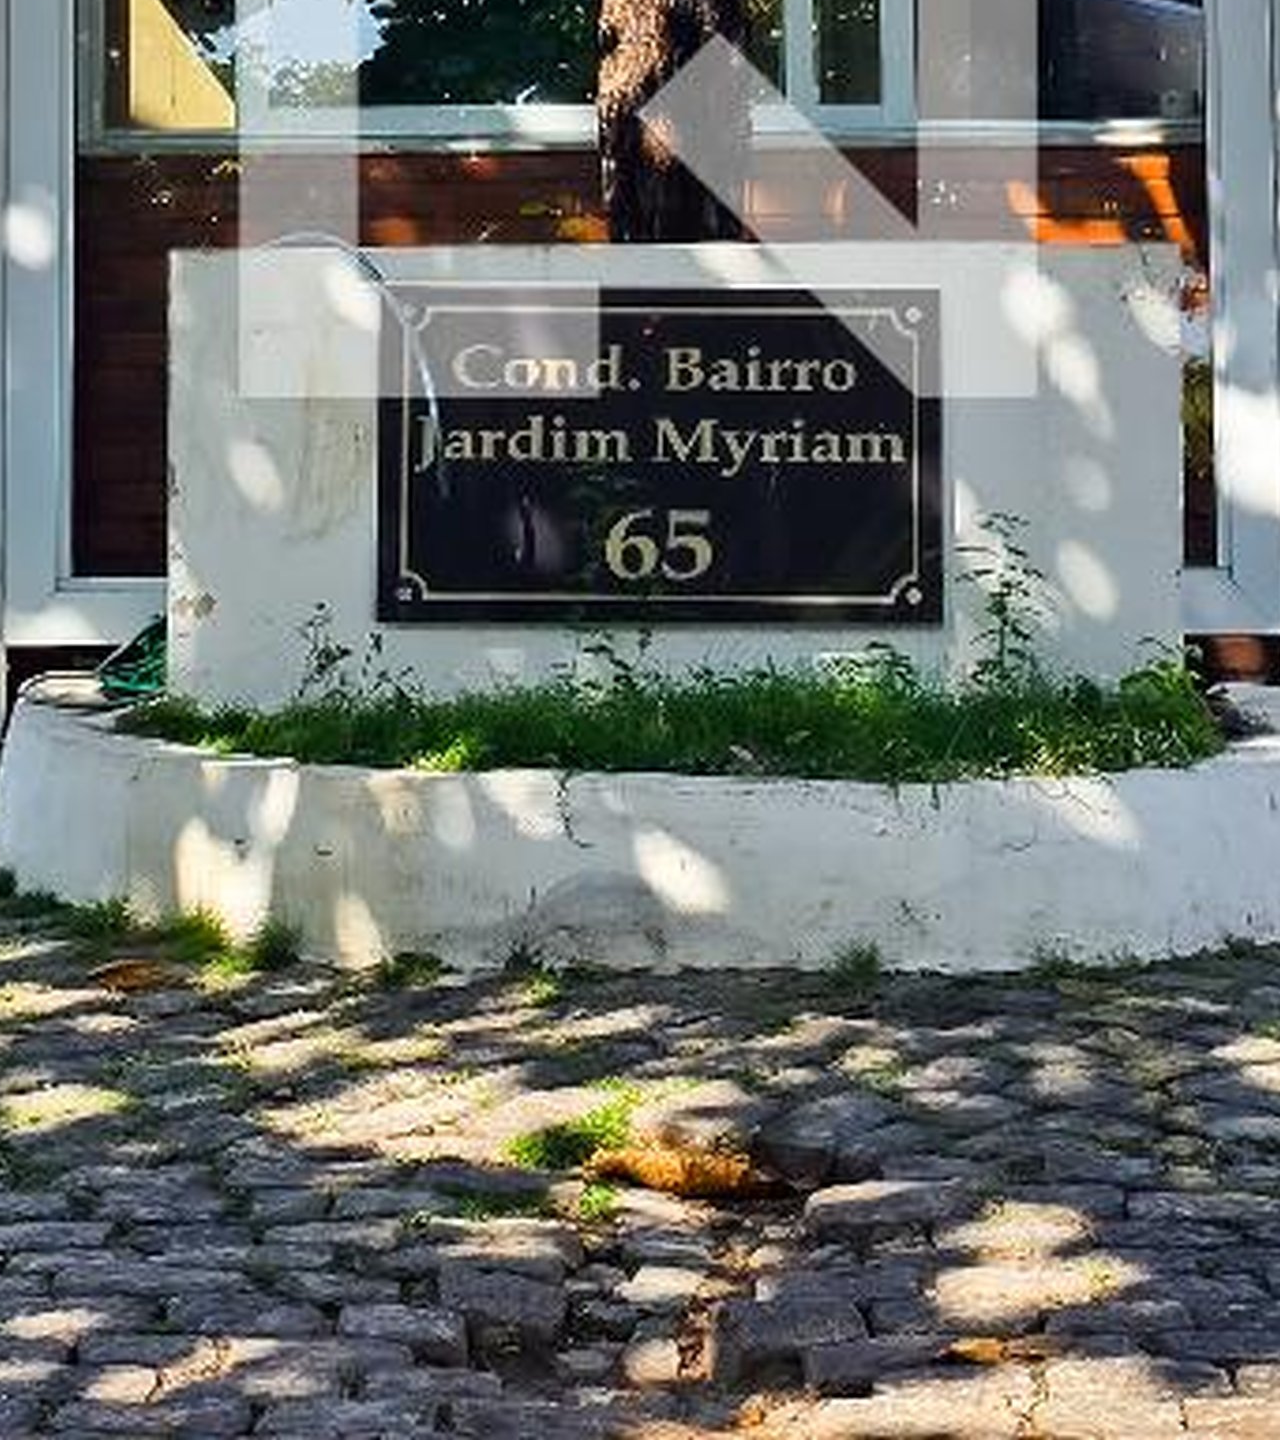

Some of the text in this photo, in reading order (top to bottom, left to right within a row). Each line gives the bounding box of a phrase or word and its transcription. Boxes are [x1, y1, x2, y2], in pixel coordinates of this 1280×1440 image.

[452, 343, 856, 392] Cond. Bairro
[414, 415, 907, 478] Jardim Myriam
[605, 509, 714, 581] 65
